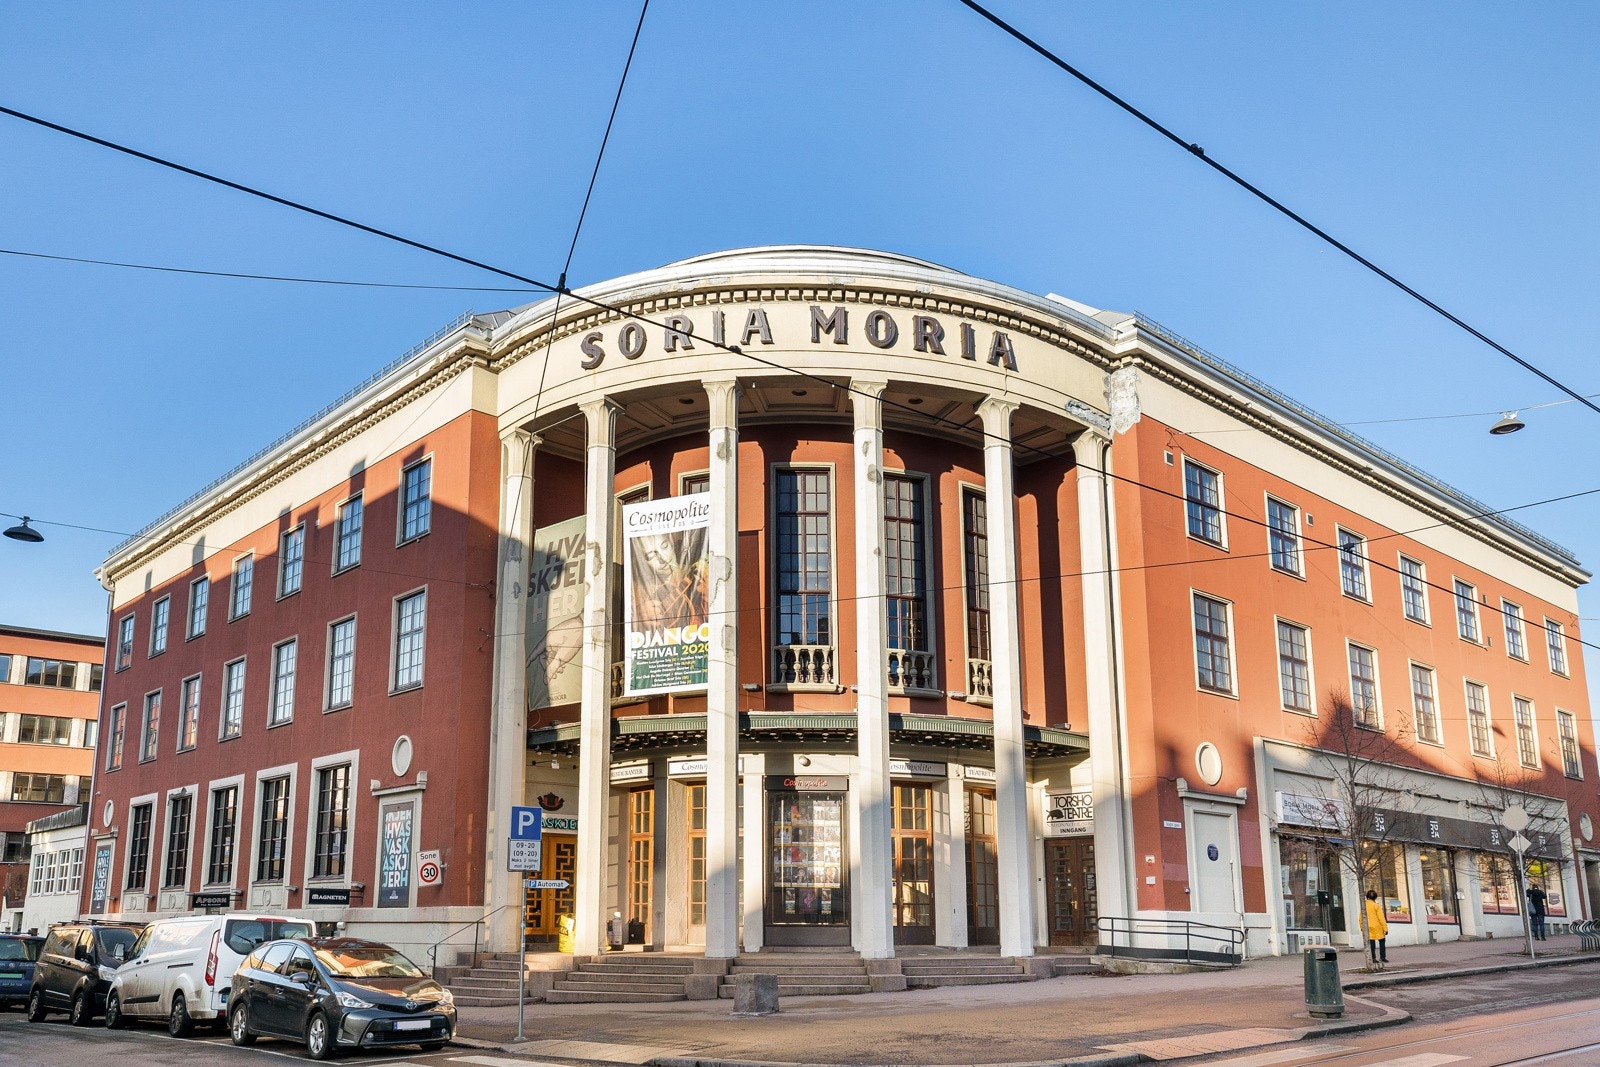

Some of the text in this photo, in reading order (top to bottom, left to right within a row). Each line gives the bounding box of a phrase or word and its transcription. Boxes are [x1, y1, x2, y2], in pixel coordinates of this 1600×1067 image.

[580, 305, 1018, 372] SORIA MORIA
[629, 501, 709, 527] Cosmopolite
[546, 532, 586, 565] HVA
[532, 588, 579, 624] HER
[631, 623, 709, 649] DJANGO
[631, 646, 679, 660] FESTIVAL
[890, 763, 932, 772] osmopolite
[783, 778, 828, 789] Cosmopolite
[1054, 794, 1092, 808] TORSHO
[1062, 807, 1092, 819] TEATRE
[385, 820, 411, 838] HVAS
[518, 811, 535, 835] P
[384, 837, 410, 855] VASK
[382, 854, 410, 871] ASKJ
[420, 852, 436, 860] Sone
[423, 867, 436, 878] 30
